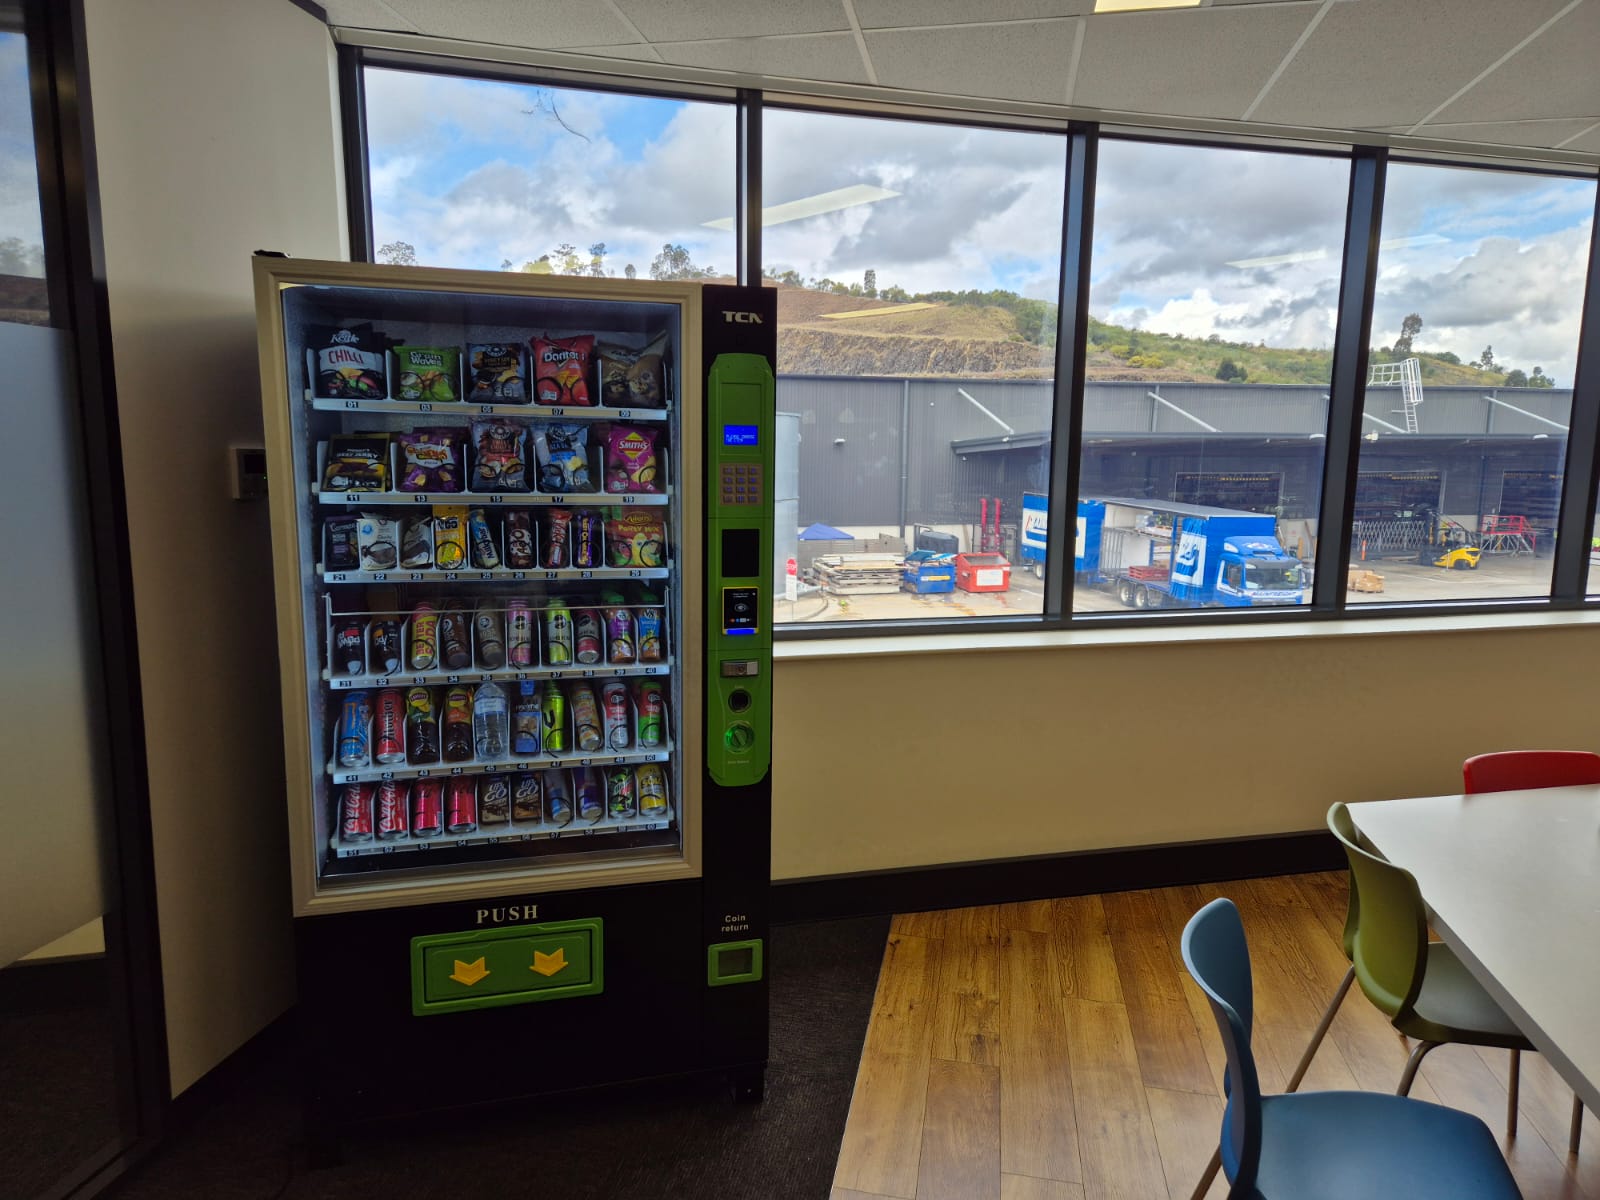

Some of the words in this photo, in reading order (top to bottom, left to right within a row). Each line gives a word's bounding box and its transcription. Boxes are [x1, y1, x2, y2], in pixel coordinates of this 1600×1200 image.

[722, 311, 764, 324] TCN
[328, 350, 364, 365] CHILLI
[544, 351, 585, 362] Doritos
[476, 904, 539, 924] PUSH
[725, 914, 746, 923] Coin
[721, 923, 749, 932] return
